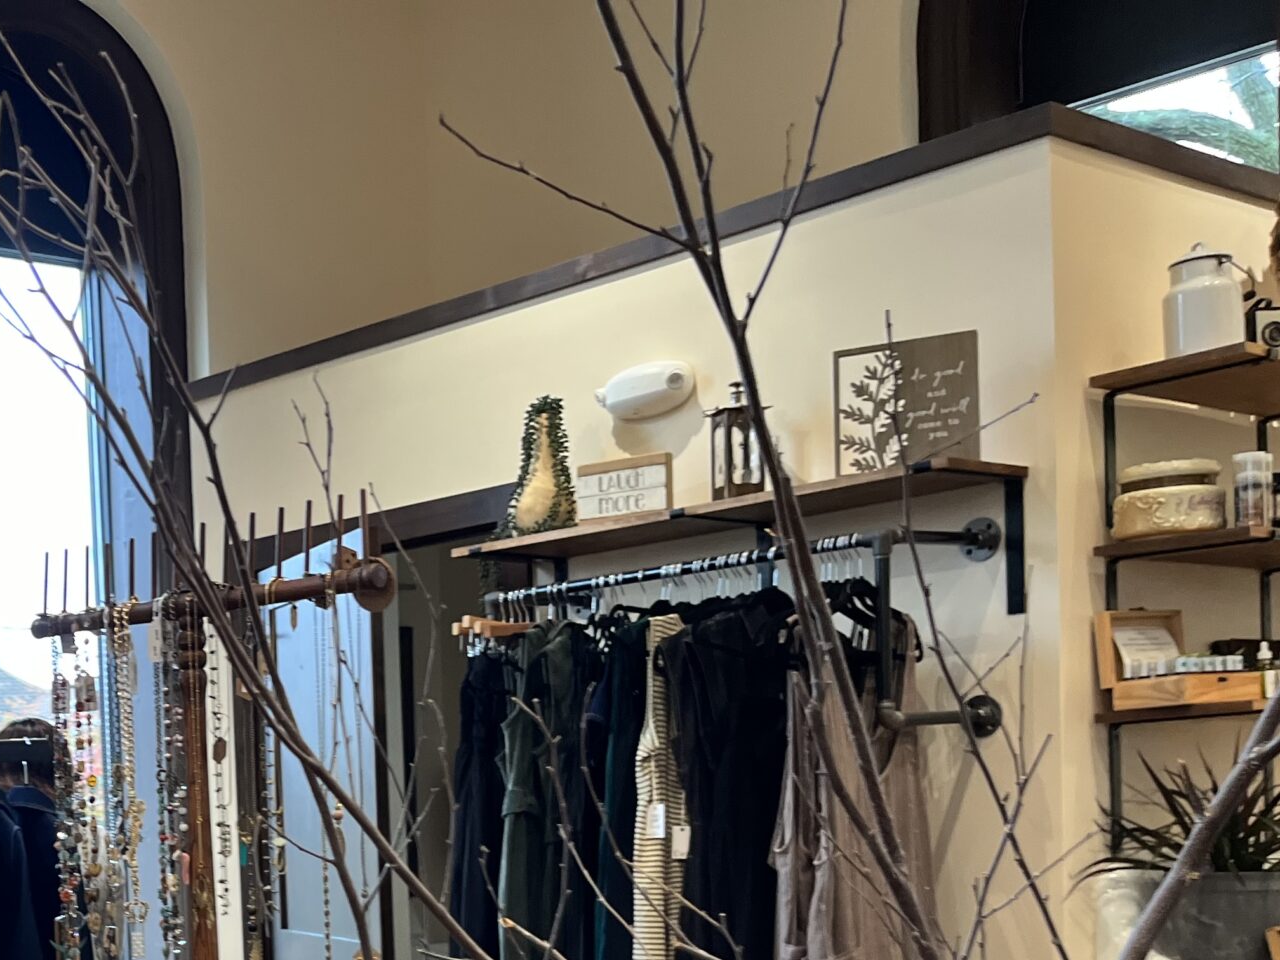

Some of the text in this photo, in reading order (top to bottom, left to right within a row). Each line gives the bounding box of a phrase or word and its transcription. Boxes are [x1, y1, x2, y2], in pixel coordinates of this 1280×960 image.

[932, 360, 965, 387] good
[926, 388, 947, 398] and
[905, 396, 971, 428] good will
[917, 418, 960, 429] come to
[928, 431, 949, 441] you
[598, 493, 646, 515] more
